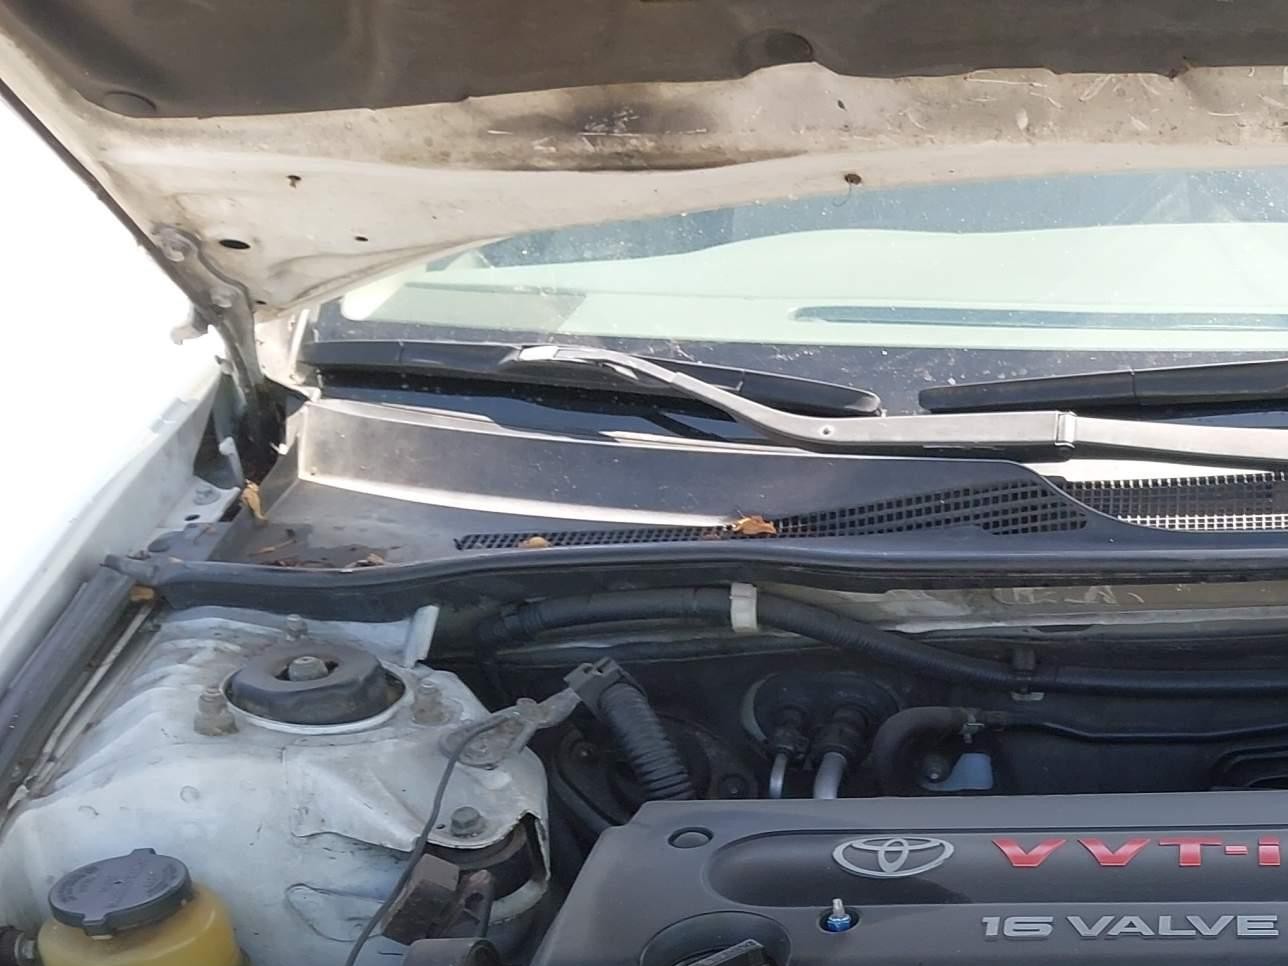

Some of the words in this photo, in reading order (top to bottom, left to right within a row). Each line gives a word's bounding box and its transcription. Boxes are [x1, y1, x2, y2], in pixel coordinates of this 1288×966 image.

[992, 838, 1281, 867] VVT-i
[981, 915, 1055, 938] 16
[1066, 915, 1280, 938] VALVE
